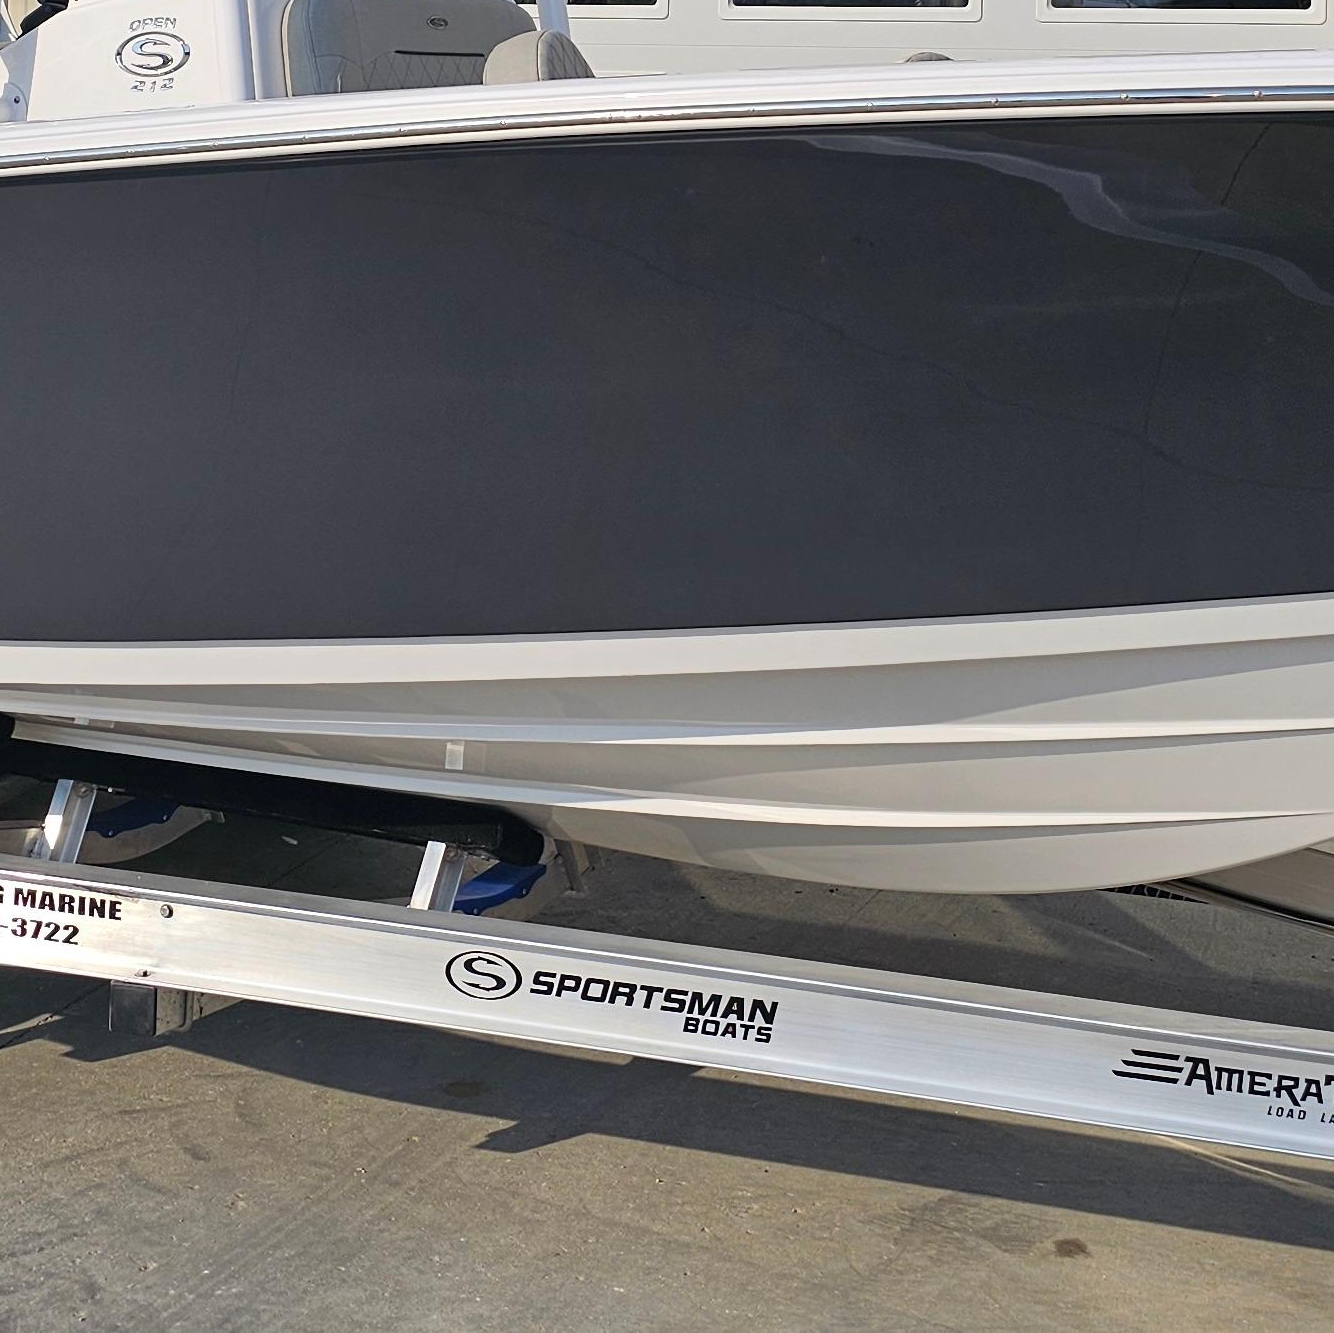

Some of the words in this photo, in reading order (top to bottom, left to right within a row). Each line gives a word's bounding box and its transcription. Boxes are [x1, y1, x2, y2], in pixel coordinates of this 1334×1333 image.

[129, 17, 177, 31] OPEN
[130, 78, 174, 92] 212
[13, 886, 123, 921] MARINE
[529, 970, 779, 1025] SPORTSMAN
[682, 1018, 773, 1044] BOATS
[1267, 1106, 1307, 1120] LOAD
